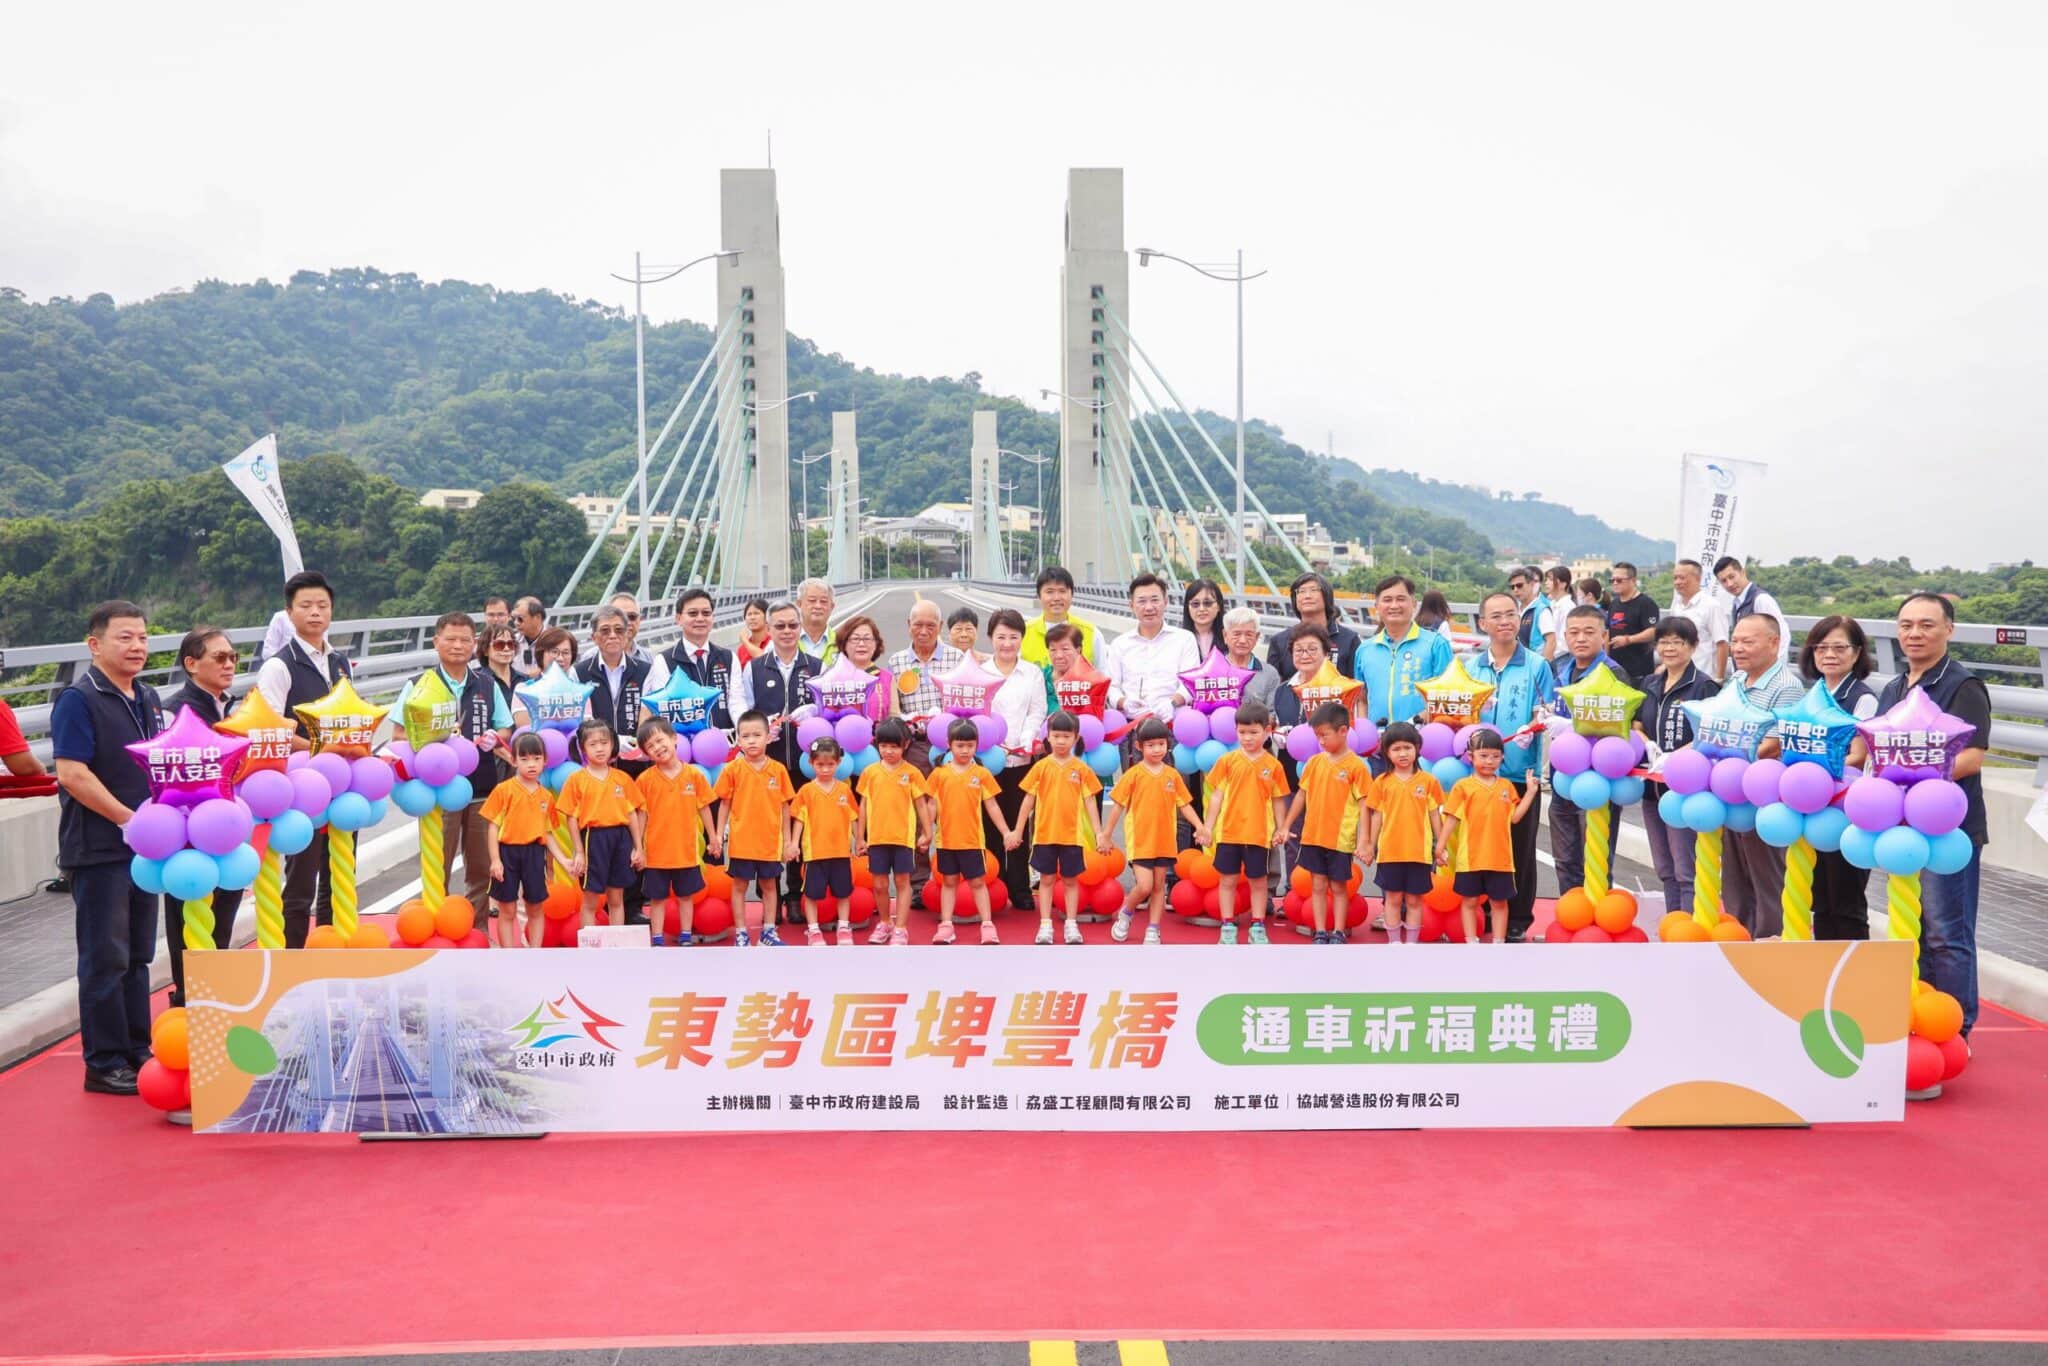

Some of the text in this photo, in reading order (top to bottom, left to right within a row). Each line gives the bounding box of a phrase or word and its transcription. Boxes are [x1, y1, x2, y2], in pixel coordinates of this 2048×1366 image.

[1700, 493, 1728, 567] 臺中市政府
[822, 693, 867, 706] 行人安全
[1194, 689, 1240, 702] 行人安全
[538, 705, 583, 720] 行人安全
[1302, 699, 1342, 712] 行人
[1427, 703, 1471, 716] 行人安全
[1573, 707, 1626, 722] 行人安全
[319, 730, 373, 745] 行人安全
[1697, 728, 1757, 750] 行人安全
[1874, 748, 1946, 766] 行人安全
[150, 763, 223, 783] 行人安全
[634, 989, 1179, 1070] 東勢區埤豐橋
[1241, 1003, 1599, 1055] 通車祈福典禮
[516, 1051, 617, 1069] 臺中市政府
[706, 1094, 920, 1111] 主辦機關 臺中市政府建設局
[943, 1094, 1009, 1110] 設計監造
[1214, 1093, 1460, 1110] 施工單位 協誠營造股份有限公司
